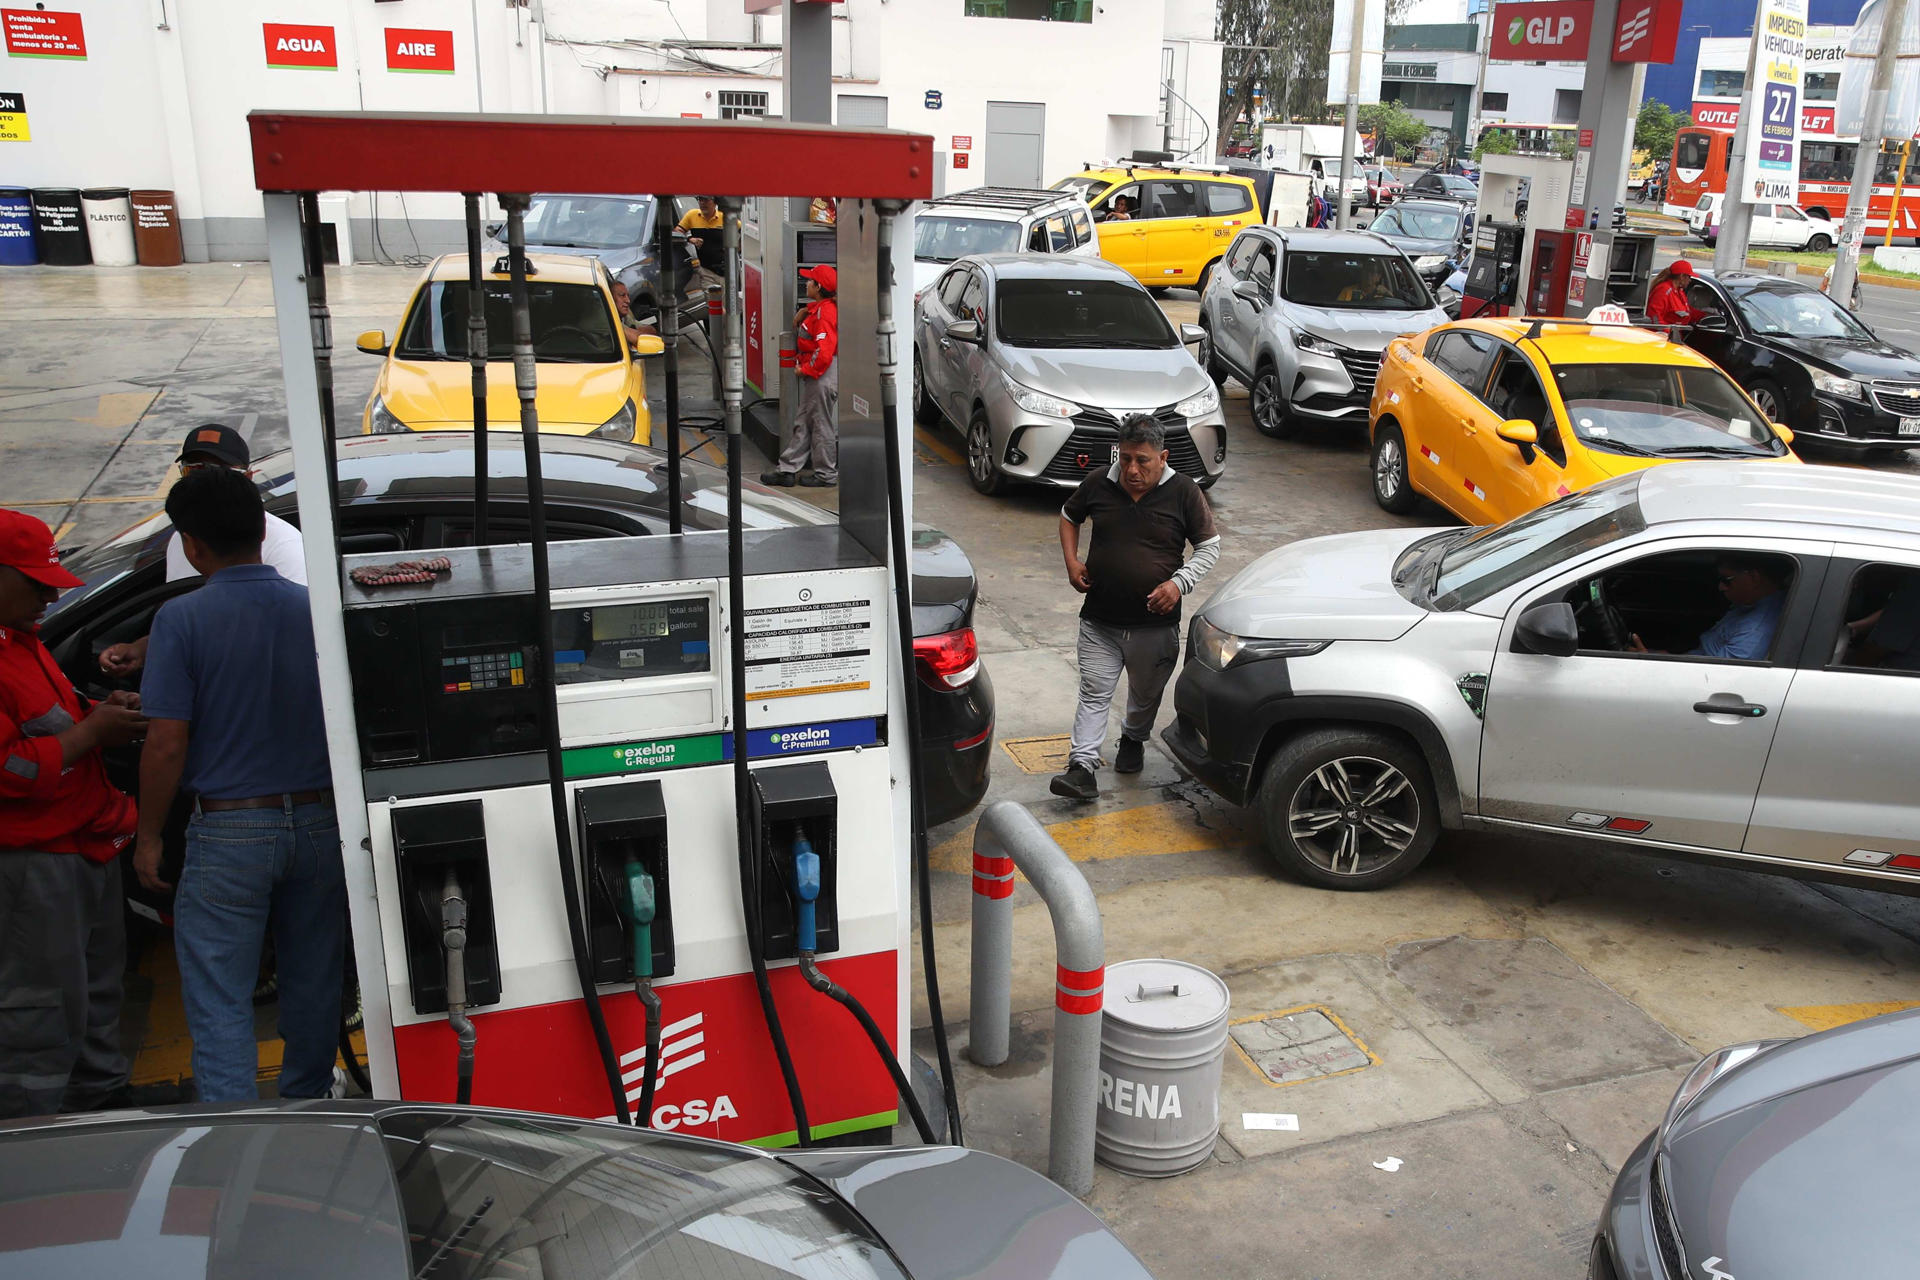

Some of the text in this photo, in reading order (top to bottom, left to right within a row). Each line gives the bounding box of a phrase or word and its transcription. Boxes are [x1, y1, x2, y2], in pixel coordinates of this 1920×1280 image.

[8, 14, 46, 24] Prohibida
[1768, 14, 1804, 38] IMPUESTO
[11, 32, 60, 41] ambulatoria
[1526, 16, 1575, 45] GLP
[42, 41, 53, 49] de
[276, 37, 326, 53] AGUA
[396, 42, 436, 57] AIRE
[1764, 34, 1804, 58] VEHICULAR
[1769, 90, 1792, 123] 27
[1764, 124, 1793, 137] DE FEBRERO
[1765, 183, 1790, 200] LIMA
[90, 213, 127, 222] PLÁSTICO
[1599, 311, 1625, 323] TAXI
[583, 611, 591, 623] $
[669, 607, 686, 615] total
[688, 605, 705, 614] sale
[669, 621, 698, 632] gallons
[781, 728, 830, 742] exelon
[624, 743, 676, 758] exelon
[781, 739, 830, 751] G-Premium
[625, 753, 676, 767] G-Regular
